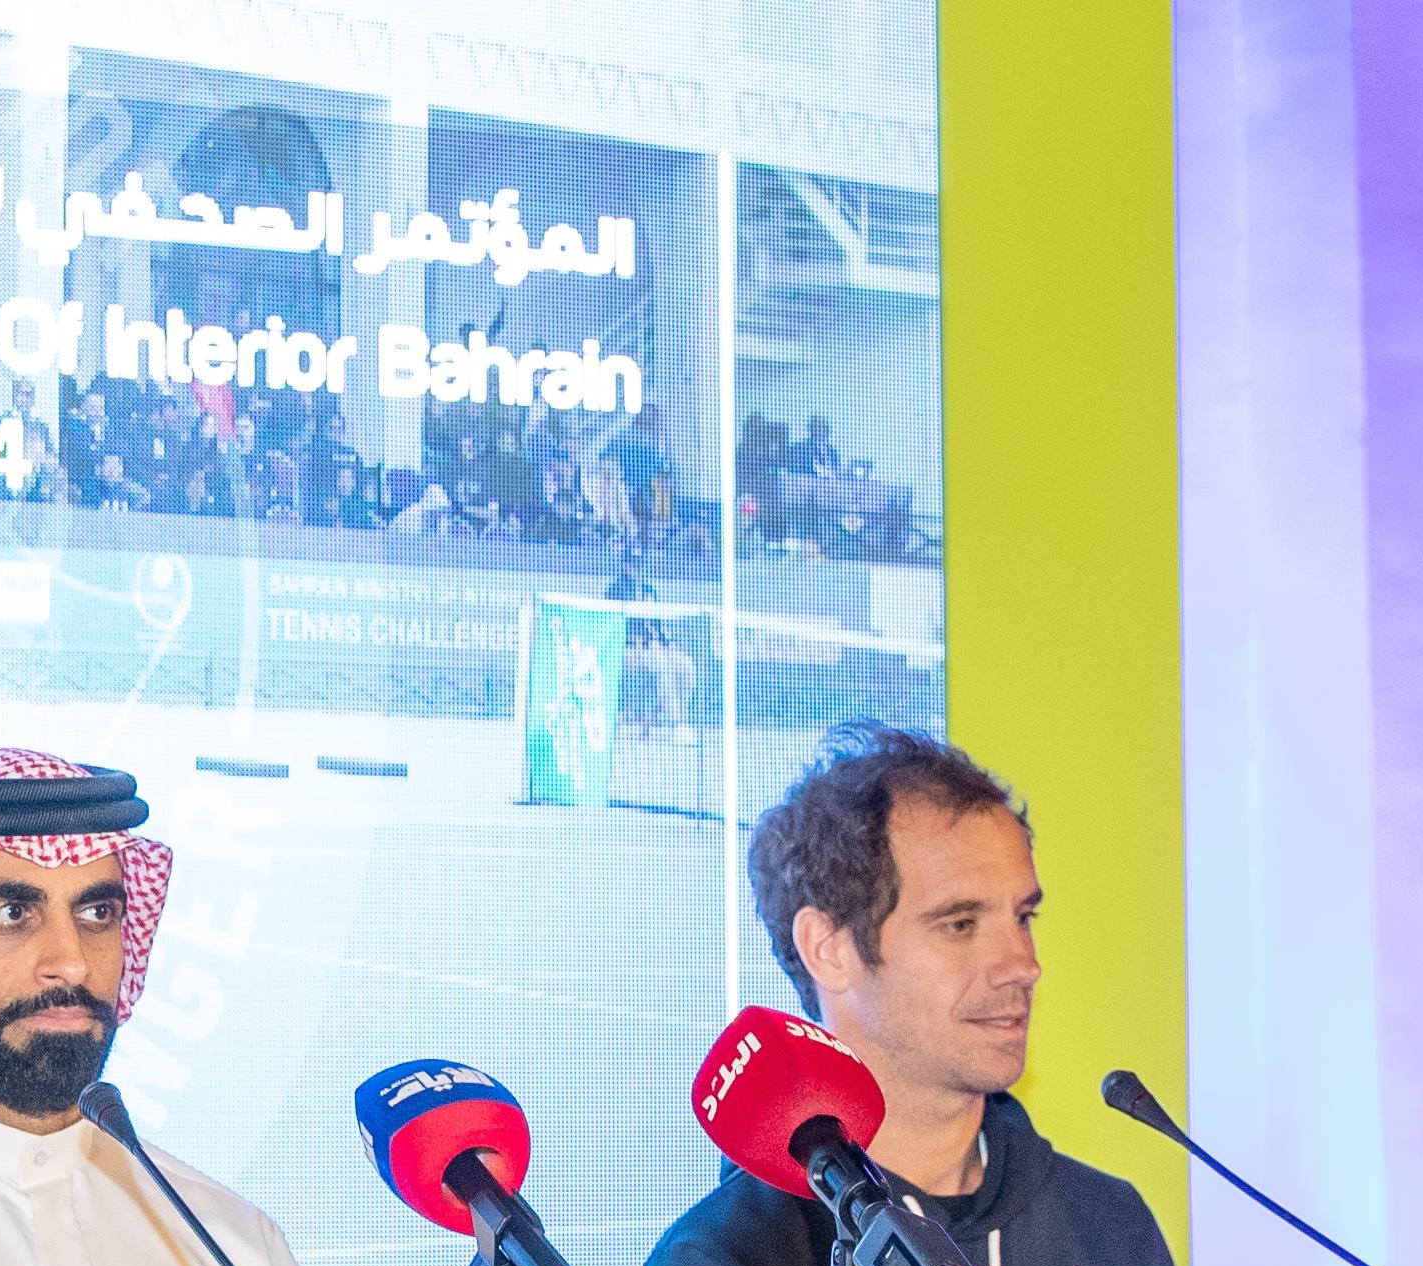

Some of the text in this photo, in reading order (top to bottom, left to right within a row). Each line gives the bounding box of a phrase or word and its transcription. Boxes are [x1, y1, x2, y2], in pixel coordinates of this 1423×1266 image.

[15, 171, 344, 267] الصحفي
[353, 188, 636, 285] المؤتمر
[105, 303, 357, 394] Interior
[378, 322, 643, 414] Bahrain
[267, 607, 362, 643] TENNIS
